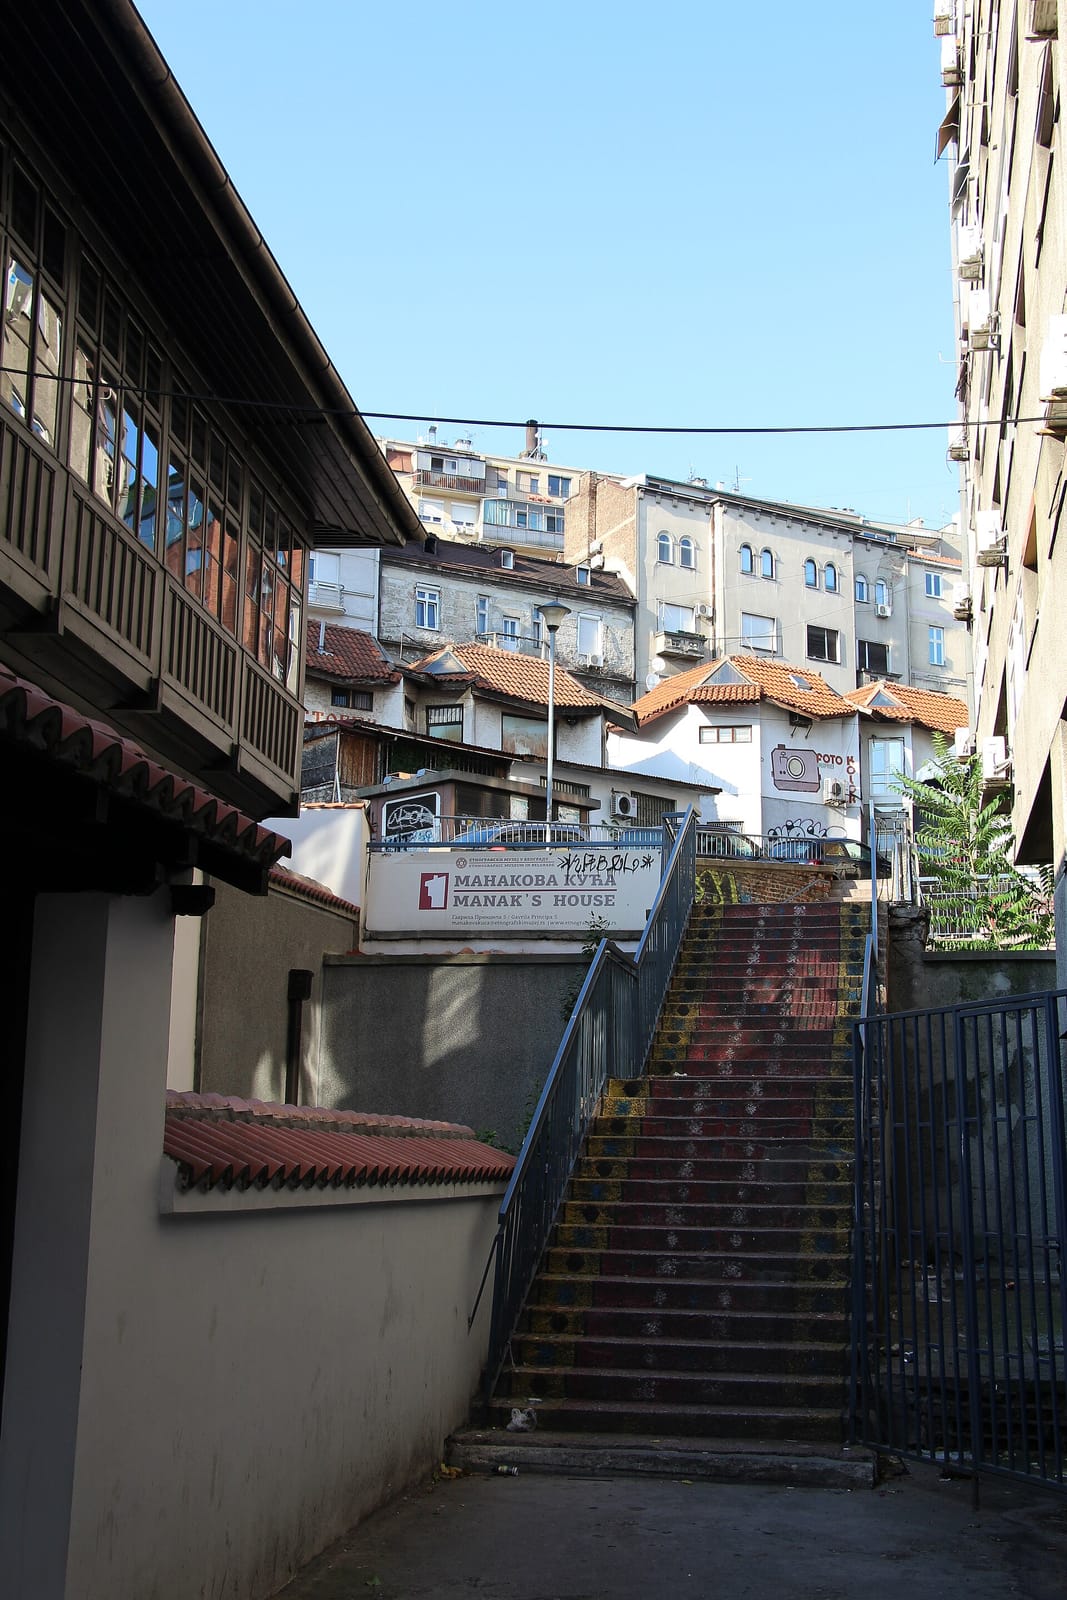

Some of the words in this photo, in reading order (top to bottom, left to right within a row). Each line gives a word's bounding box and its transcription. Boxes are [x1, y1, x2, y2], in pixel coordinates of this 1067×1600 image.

[816, 753, 843, 765] FOTO
[454, 874, 558, 887] МАНАКОВА
[563, 874, 617, 887] КУЋА
[453, 893, 542, 907] MANAK'S
[553, 894, 616, 907] HOUSE
